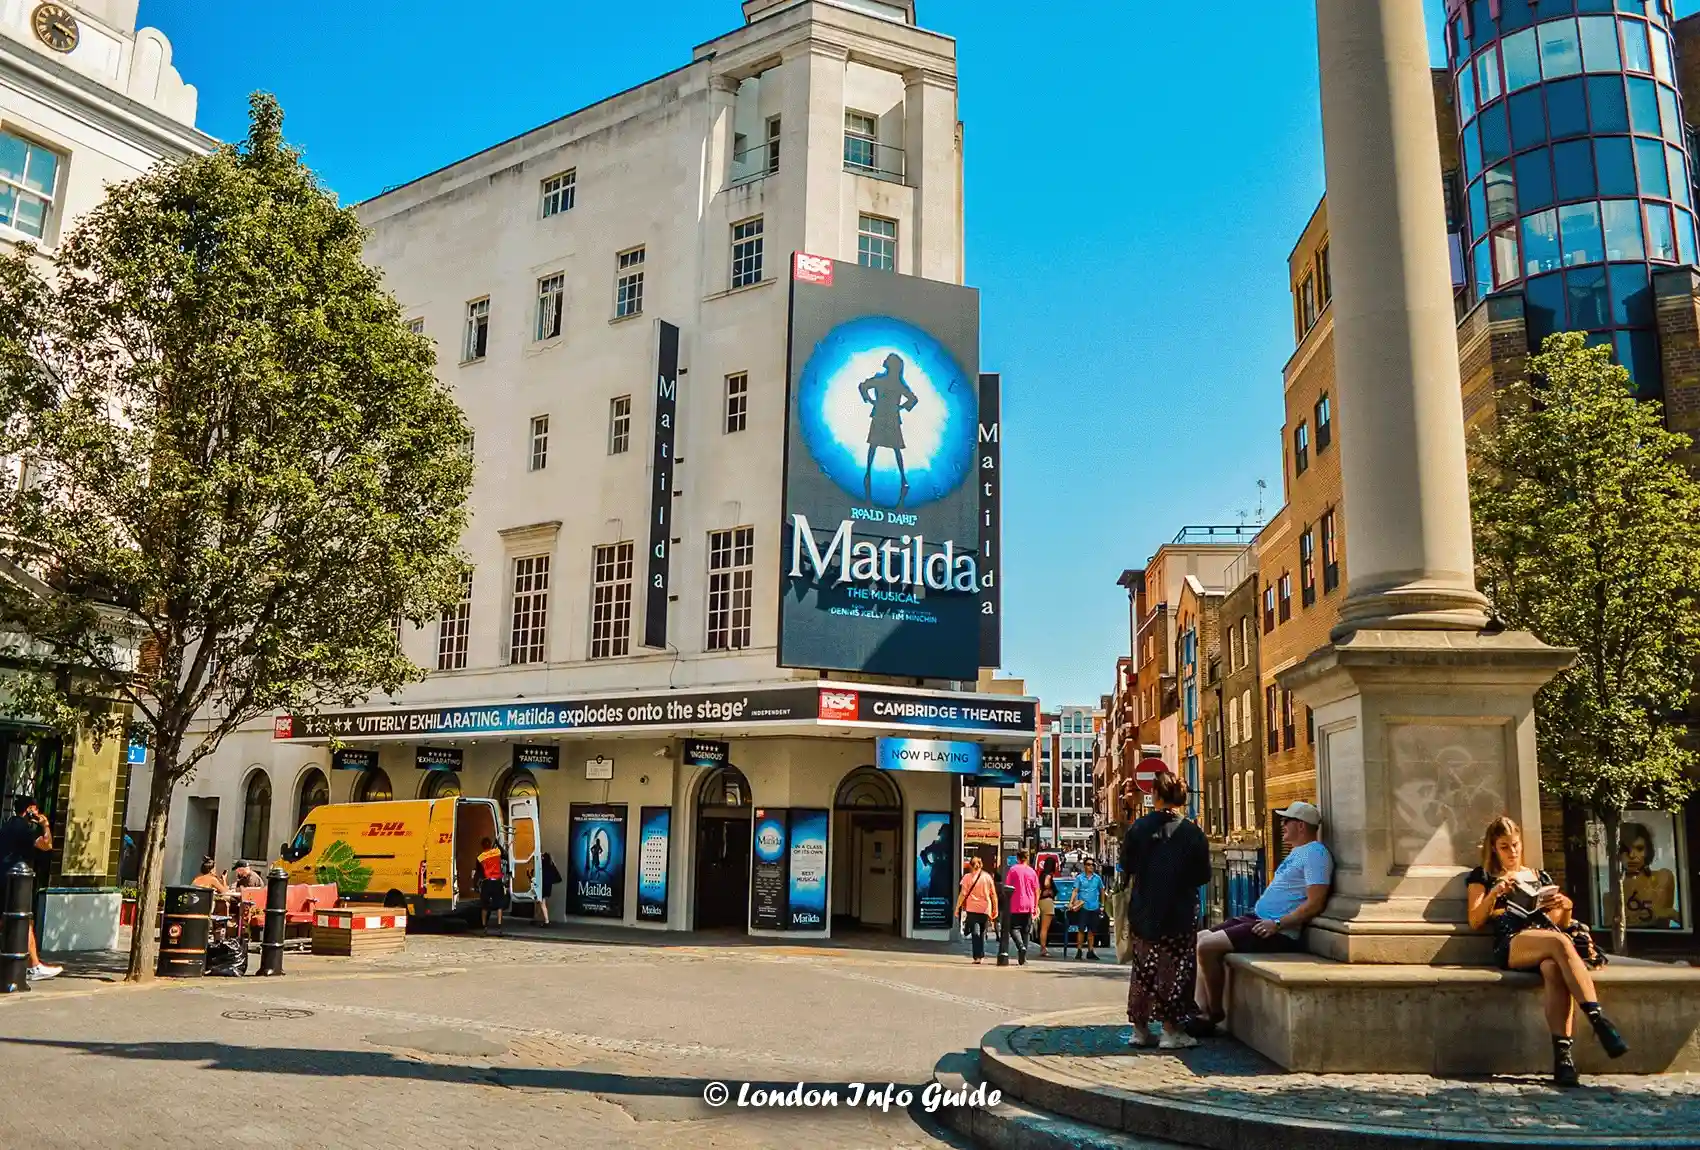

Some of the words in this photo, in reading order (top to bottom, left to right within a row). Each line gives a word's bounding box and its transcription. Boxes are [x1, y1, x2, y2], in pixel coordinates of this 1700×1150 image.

[797, 253, 830, 275] RSC
[653, 375, 676, 588] Matilda
[851, 507, 884, 521] ROALD
[979, 424, 999, 615] Matilda
[788, 514, 981, 593] Matilda
[847, 587, 869, 599] THE
[871, 590, 920, 605] MUSICAL
[830, 606, 860, 617] DENNIS
[891, 611, 905, 620] TIM
[905, 613, 938, 624] MINCHIN
[822, 692, 856, 710] RSC
[507, 708, 554, 726] Matilda
[558, 704, 623, 727] explodes
[627, 704, 663, 721] onto
[666, 700, 693, 719] the
[751, 708, 791, 717] INDEPENDENT
[873, 701, 957, 719] CAMBRIDGE
[961, 707, 1021, 723] THEATRE
[892, 749, 920, 760] NOW
[923, 751, 969, 763] PLAYING
[367, 823, 406, 836] DHL
[578, 881, 612, 897] Matilda
[641, 905, 662, 915] Matilda
[793, 913, 820, 924] Matilda
